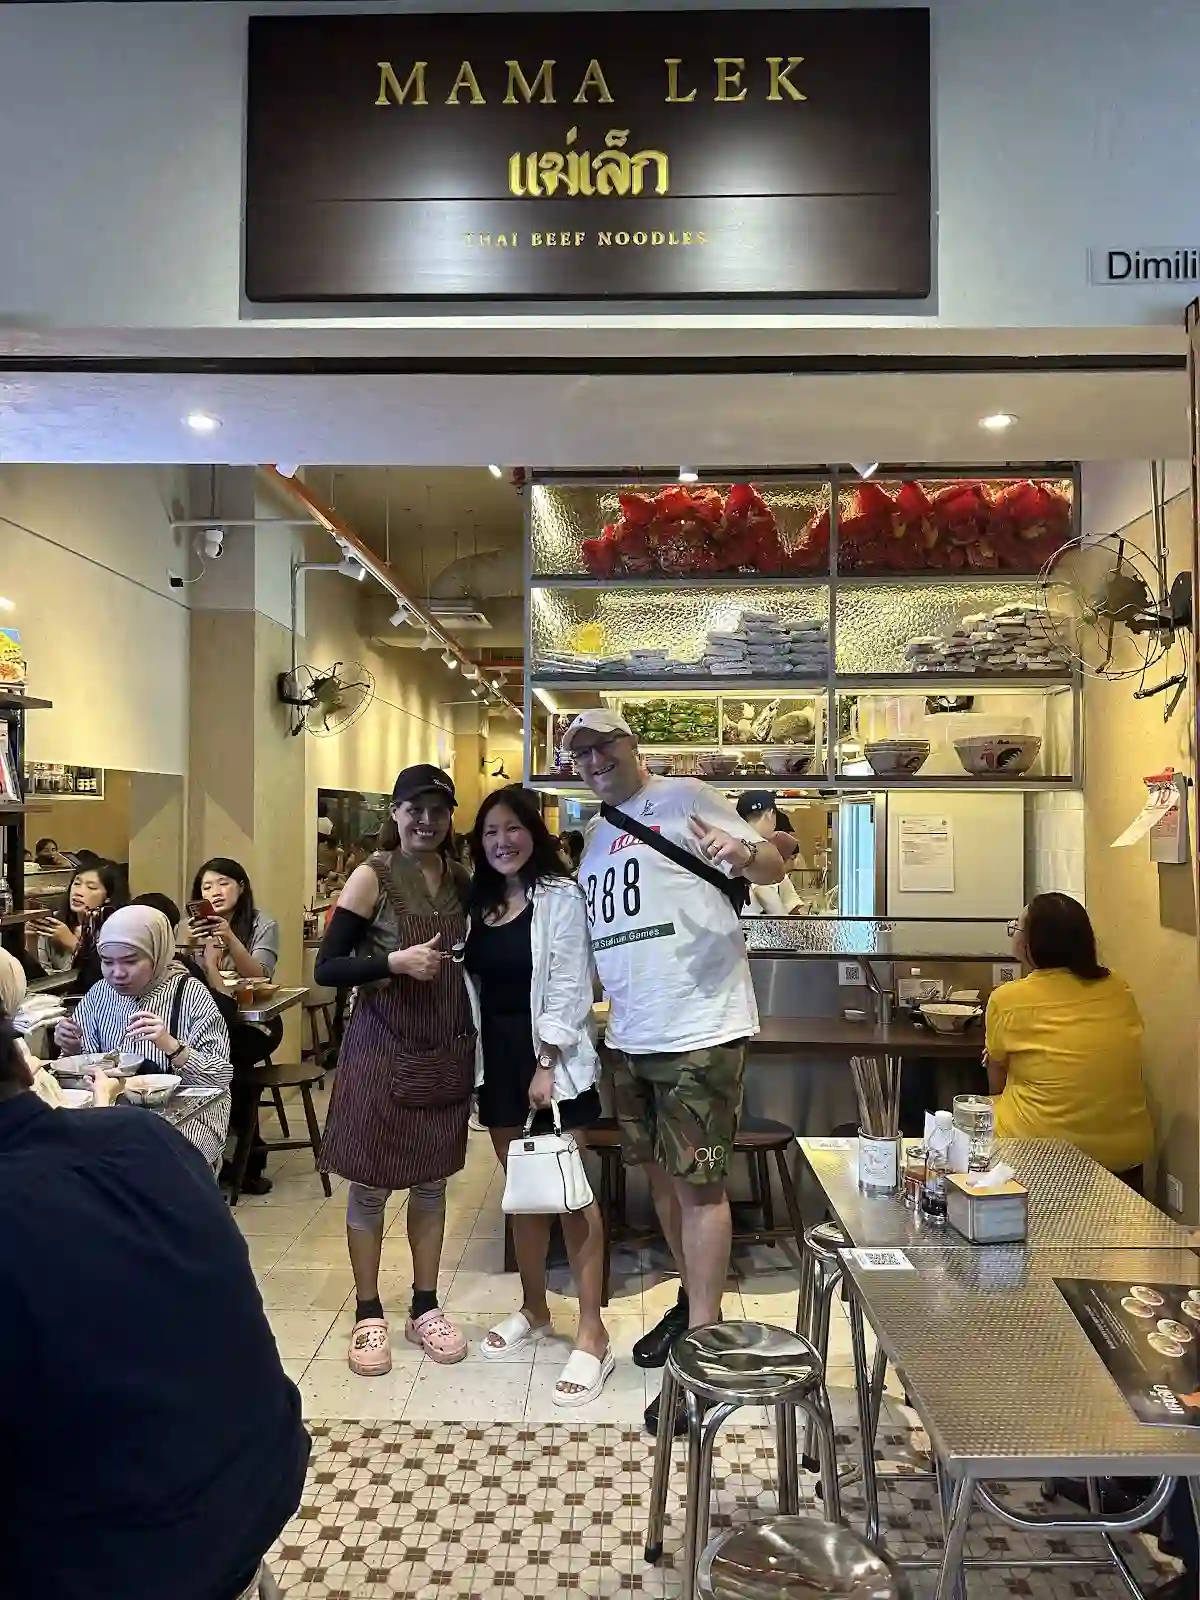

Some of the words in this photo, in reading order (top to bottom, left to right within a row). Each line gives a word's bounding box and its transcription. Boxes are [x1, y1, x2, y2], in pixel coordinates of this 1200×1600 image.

[375, 59, 614, 105] MAMA
[664, 56, 808, 103] LEK
[507, 126, 670, 197] แม่เล็ก
[464, 231, 519, 248] THAI
[531, 230, 586, 248] BEEF
[597, 229, 709, 247] NOODLES
[1108, 250, 1200, 279] Dimili
[628, 928, 660, 941] Games
